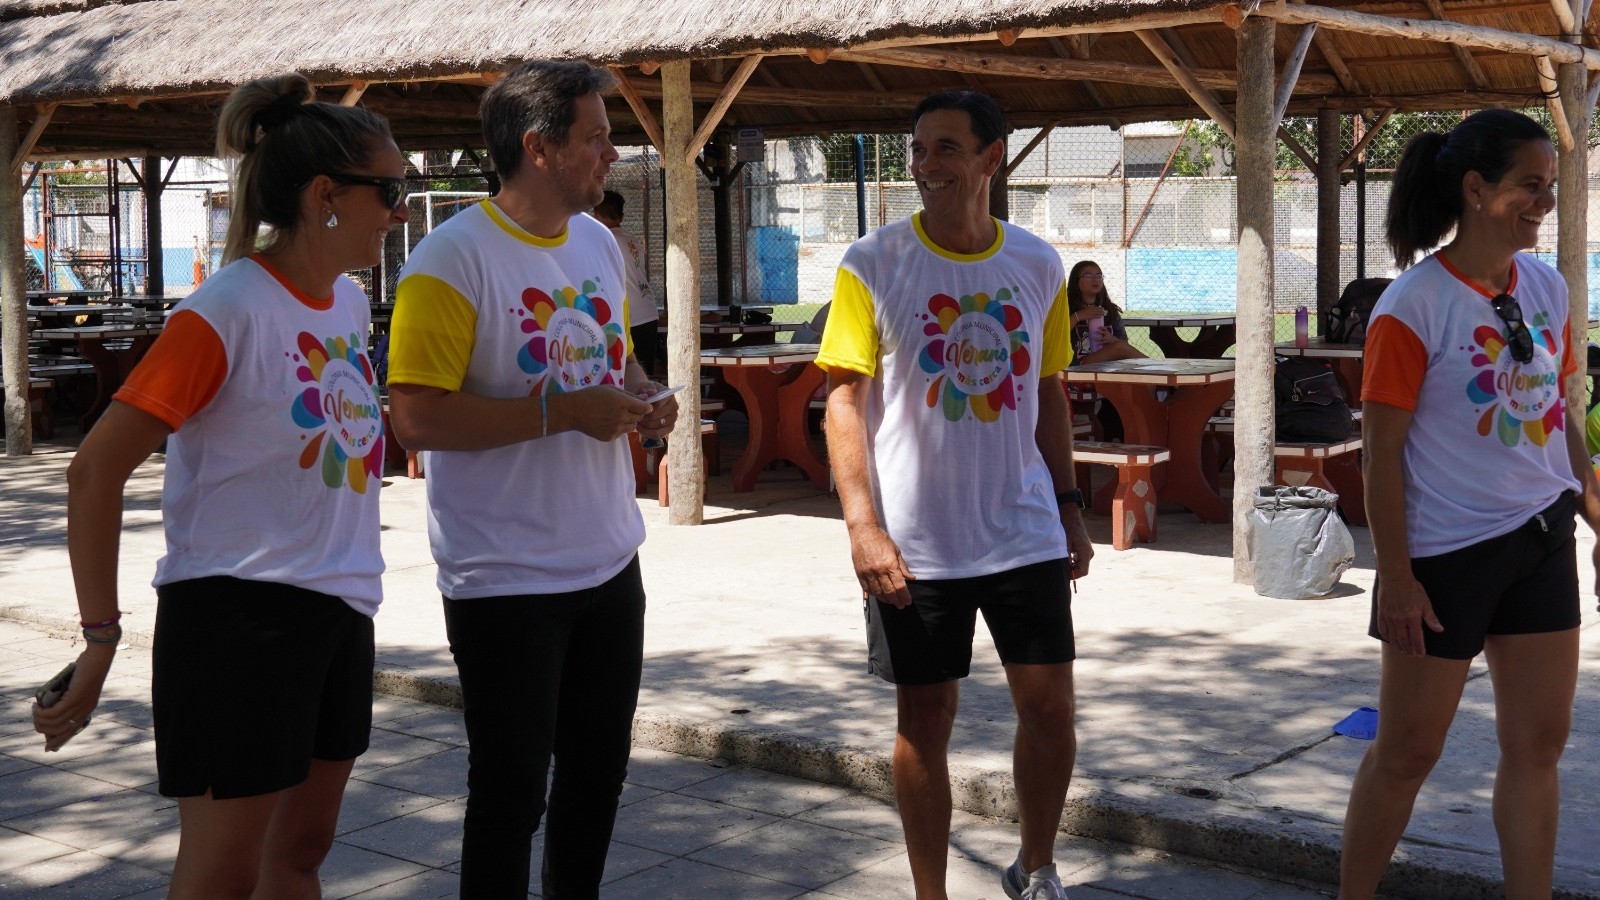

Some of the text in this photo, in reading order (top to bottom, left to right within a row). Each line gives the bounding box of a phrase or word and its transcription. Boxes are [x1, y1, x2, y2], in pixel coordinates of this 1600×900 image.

[568, 318, 598, 343] MUNICIPAL
[954, 321, 1002, 346] COONIA MUNICIPAL
[549, 335, 605, 367] Verano
[946, 338, 1009, 369] Verano
[327, 370, 371, 401] COLONIA MUNICIPAL
[579, 363, 601, 386] cerca
[979, 366, 1002, 386] cerca
[1497, 365, 1556, 397] Verano
[324, 388, 379, 424] Verano
[1532, 390, 1551, 411] ceca
[357, 425, 376, 447] cerca
